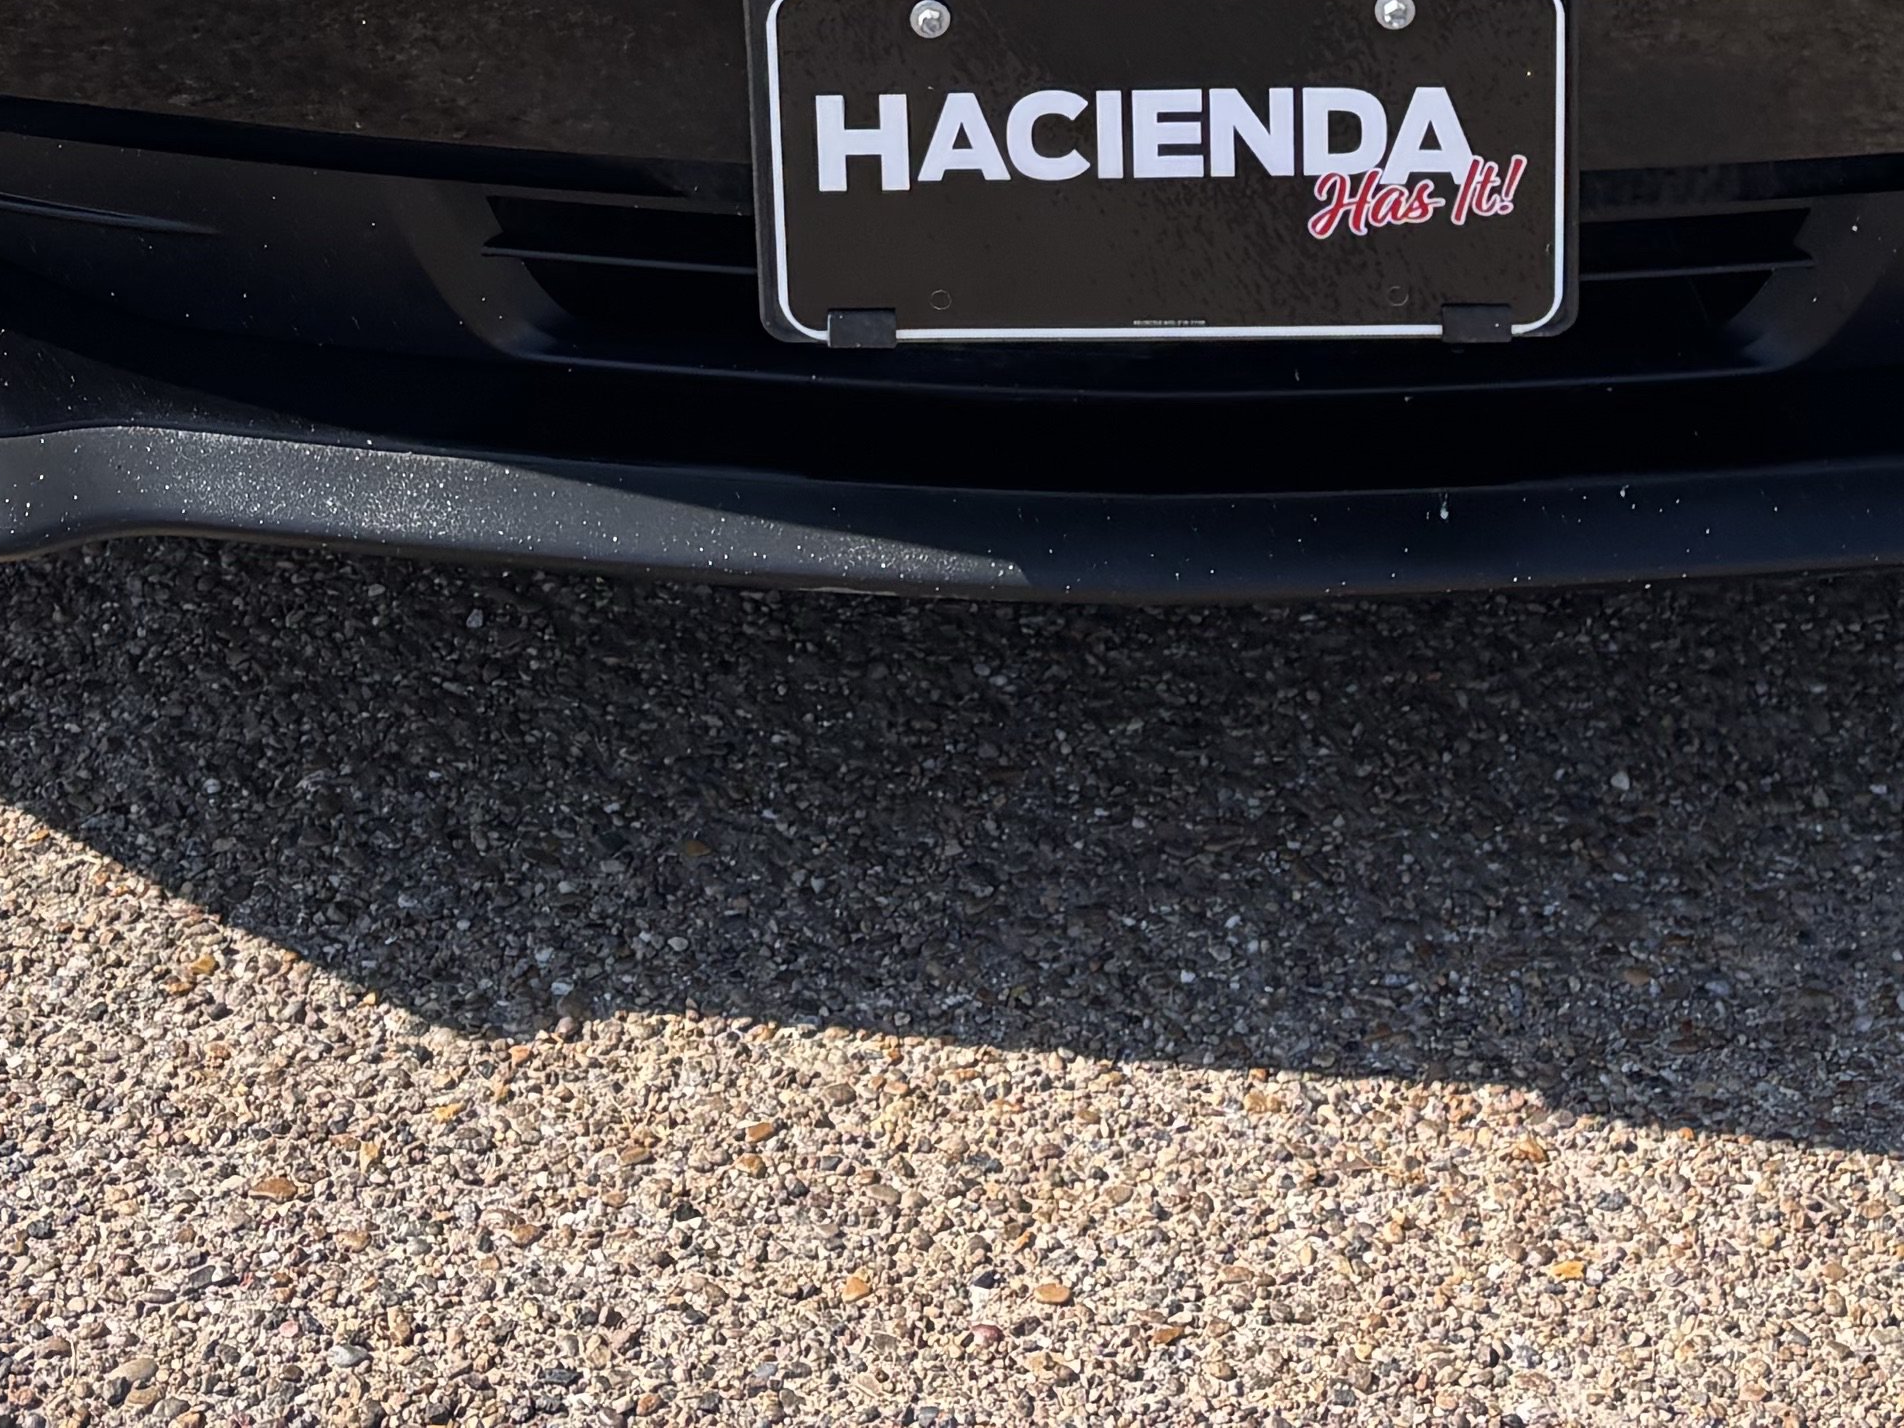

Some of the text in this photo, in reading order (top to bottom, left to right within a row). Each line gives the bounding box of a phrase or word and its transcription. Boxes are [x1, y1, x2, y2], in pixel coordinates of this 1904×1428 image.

[814, 86, 1474, 192] HACIENDA
[1307, 154, 1528, 240] Has It!
